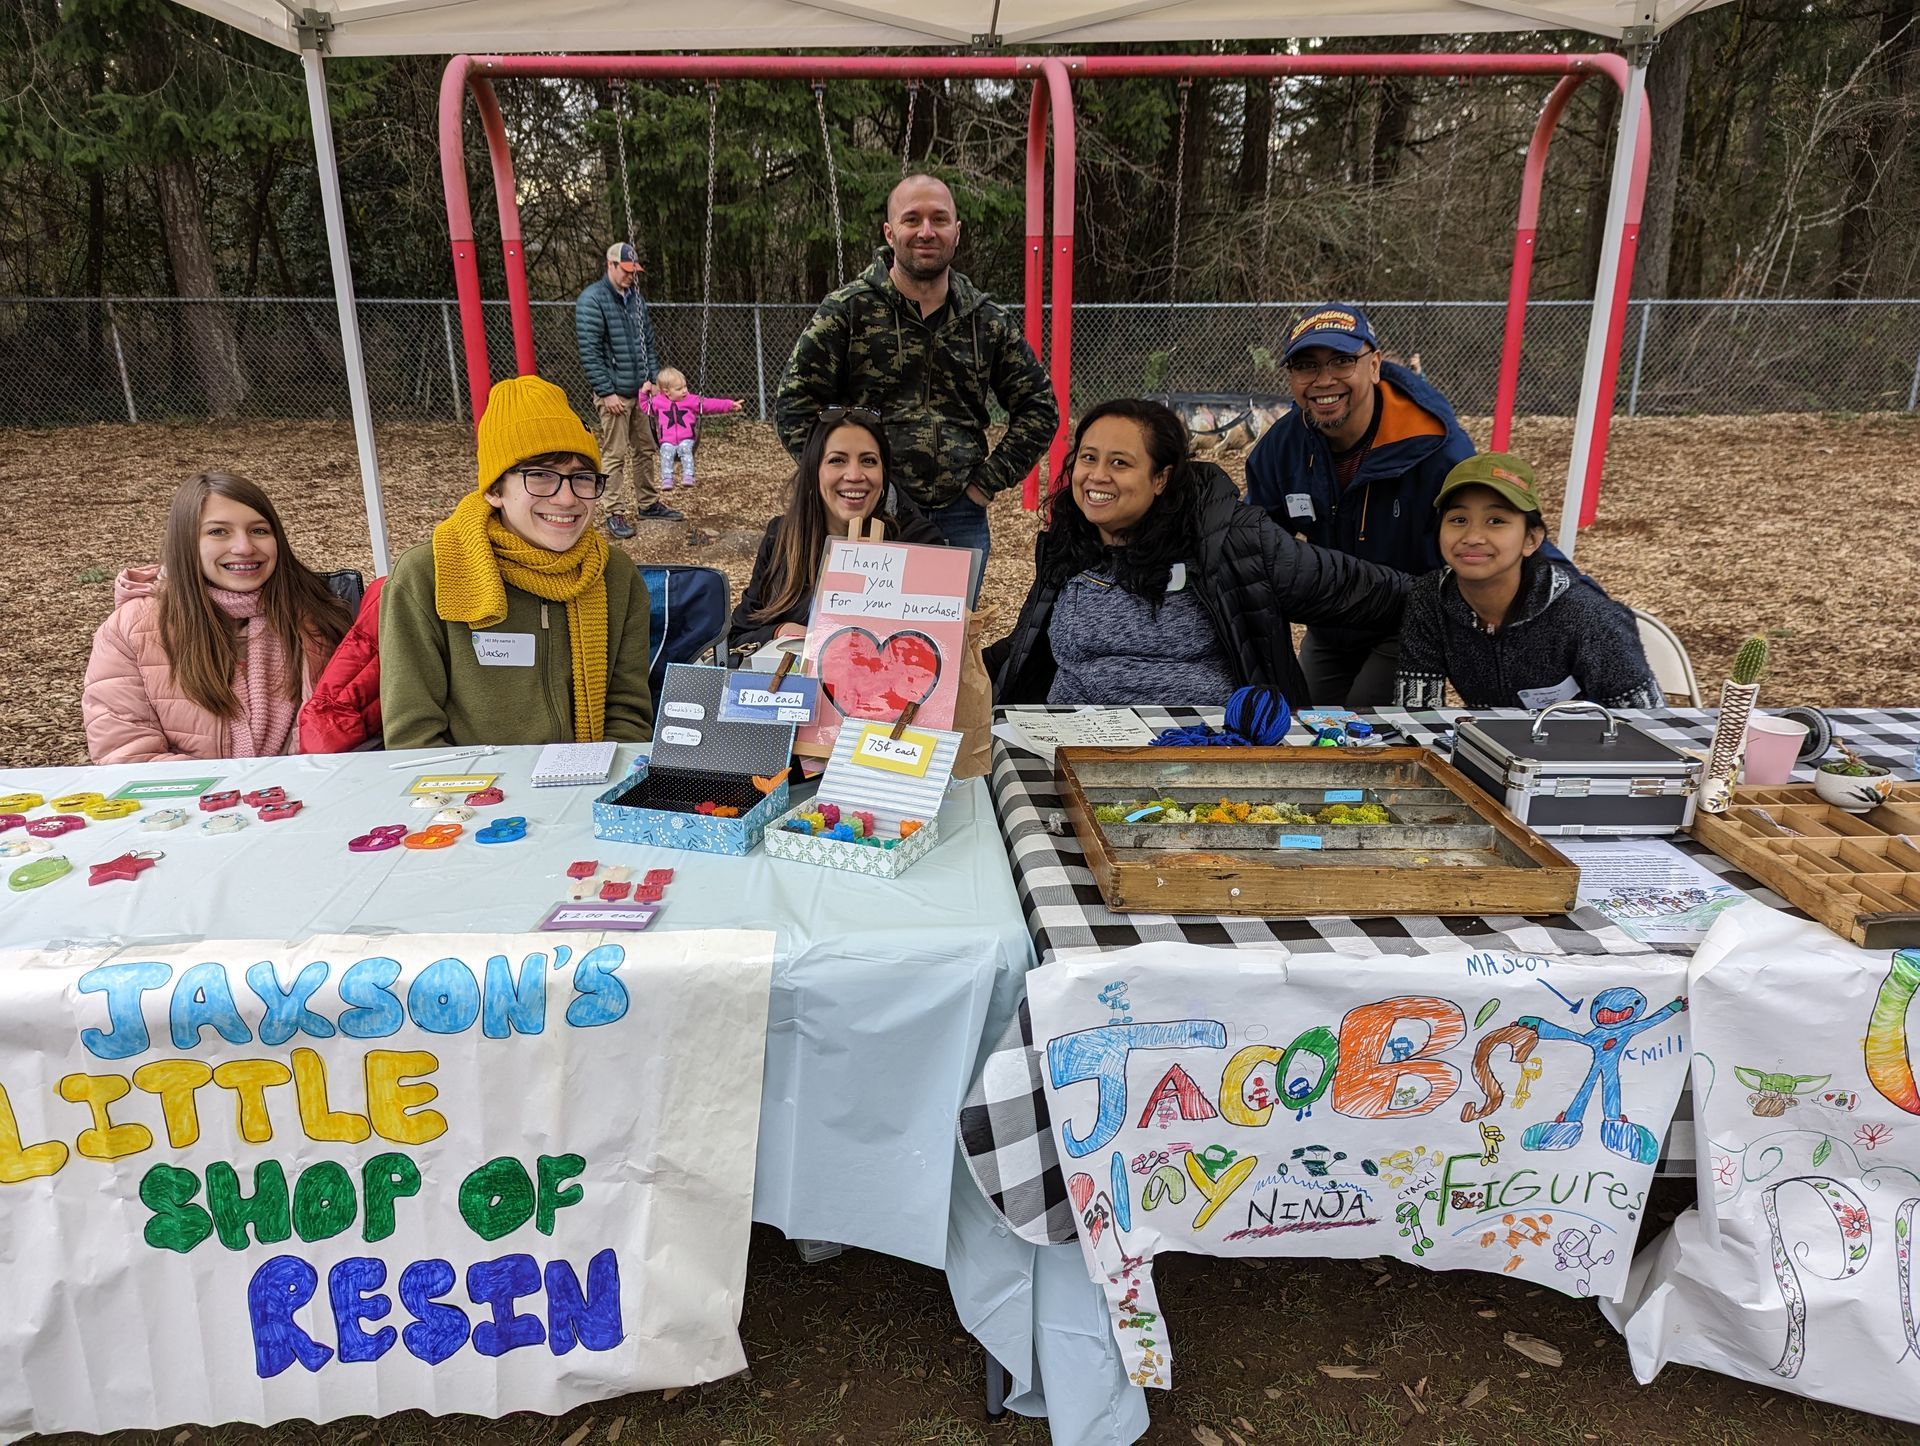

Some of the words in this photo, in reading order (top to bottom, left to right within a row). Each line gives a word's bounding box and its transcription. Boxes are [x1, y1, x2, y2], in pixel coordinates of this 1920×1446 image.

[840, 547, 893, 572] Thank
[866, 576, 895, 595] you
[829, 593, 852, 608] for
[862, 599, 892, 612] your
[901, 602, 961, 620] purchase!
[478, 645, 509, 658] Jaxson
[740, 690, 770, 704] $1.00
[775, 694, 801, 704] each
[868, 738, 892, 753] 75¢
[894, 747, 918, 757] each
[610, 911, 645, 920] each
[79, 943, 629, 1060] JAXSON'S
[0, 1047, 449, 1184] LITTLE
[139, 1151, 422, 1254] SHOP
[458, 1152, 587, 1242] OF
[1247, 1188, 1368, 1228] NINJA
[247, 1247, 627, 1379] RESIN
